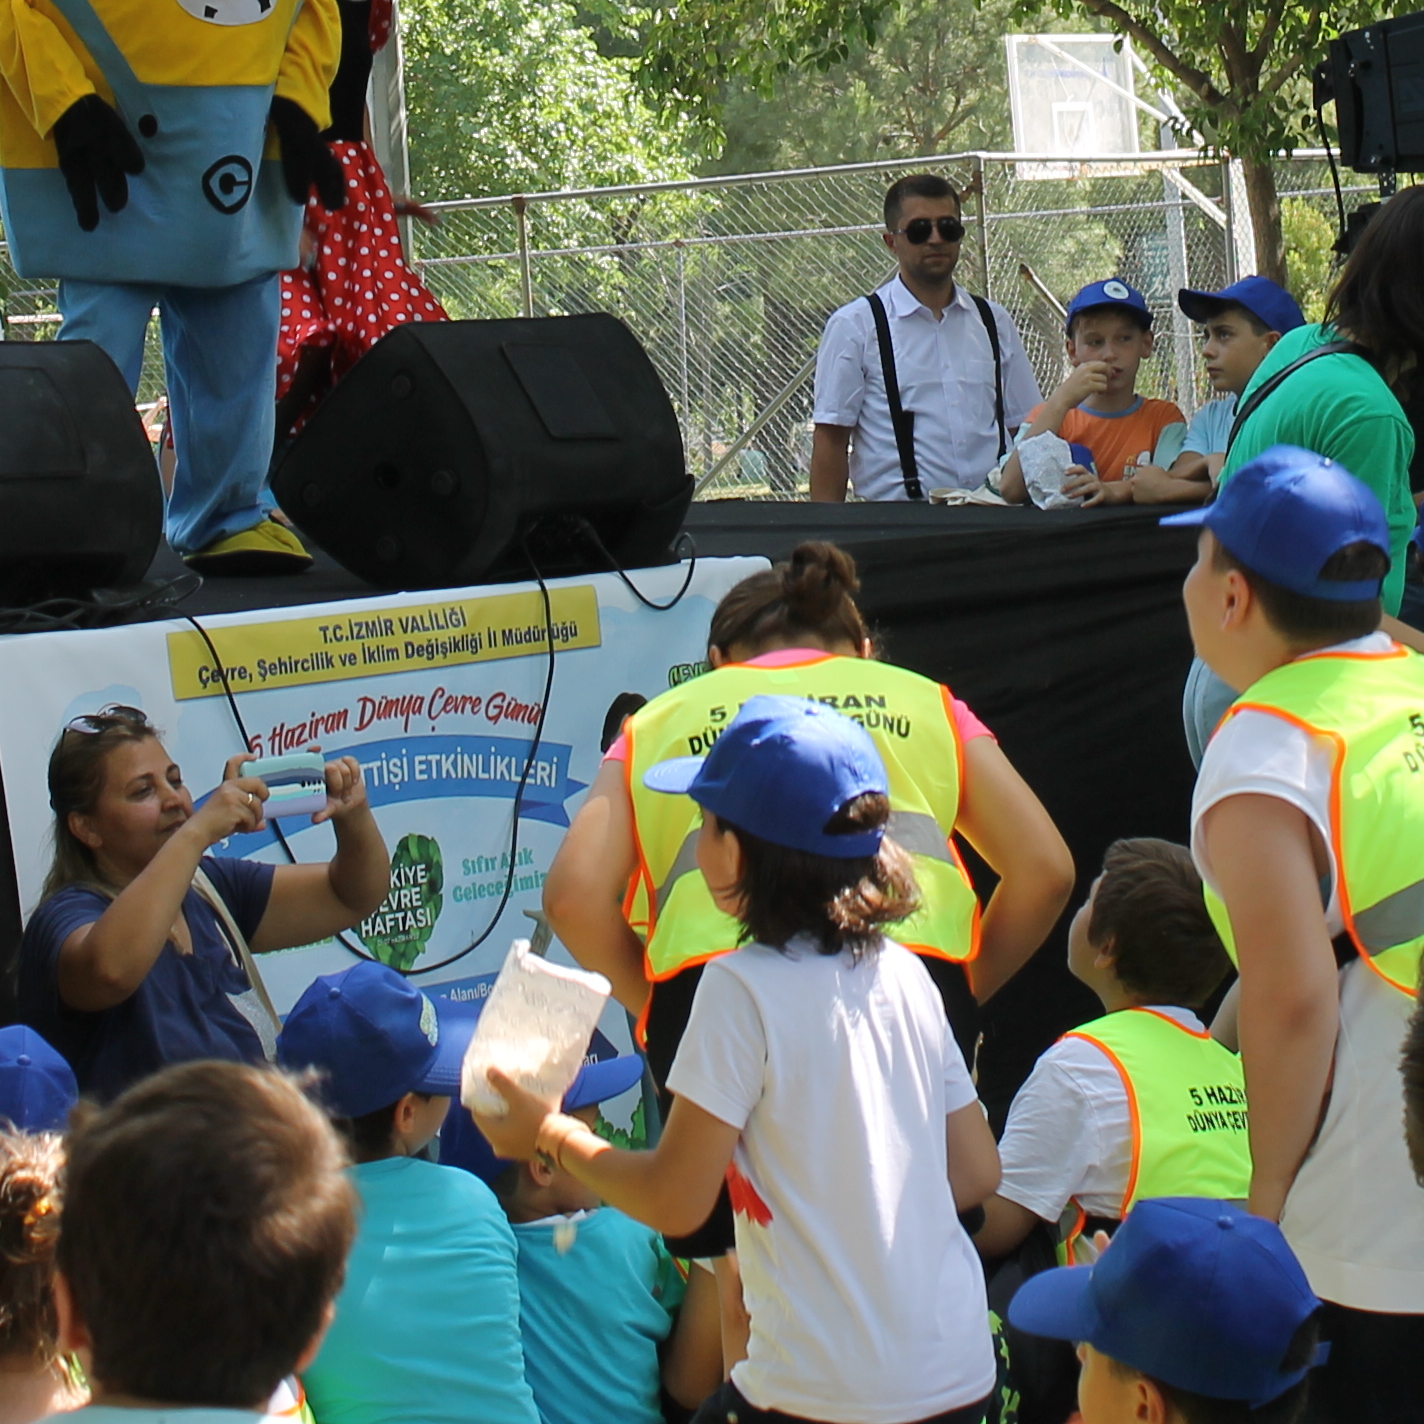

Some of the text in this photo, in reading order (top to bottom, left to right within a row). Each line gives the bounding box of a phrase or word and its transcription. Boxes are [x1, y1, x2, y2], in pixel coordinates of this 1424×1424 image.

[319, 606, 467, 644] T.C.İZMİR VALİLİĞİ
[257, 652, 335, 682] Şehircilik
[338, 653, 357, 668] ve
[361, 641, 400, 664] İklim
[404, 632, 482, 660] Değişikliği
[487, 626, 497, 648] İl
[501, 621, 578, 646] Müdürüğü
[250, 686, 543, 760] 5 Haziran Dünya Çevre Günü
[710, 705, 726, 723] 5
[414, 746, 558, 788] ETKİNLİKLERİ
[500, 847, 534, 870] Aık
[378, 886, 423, 914] EVRE
[361, 907, 432, 939] HAFTASI
[450, 982, 494, 1002] Alanı/Bo
[1188, 1087, 1204, 1107] 5
[1186, 1109, 1229, 1133] DÜNYA
